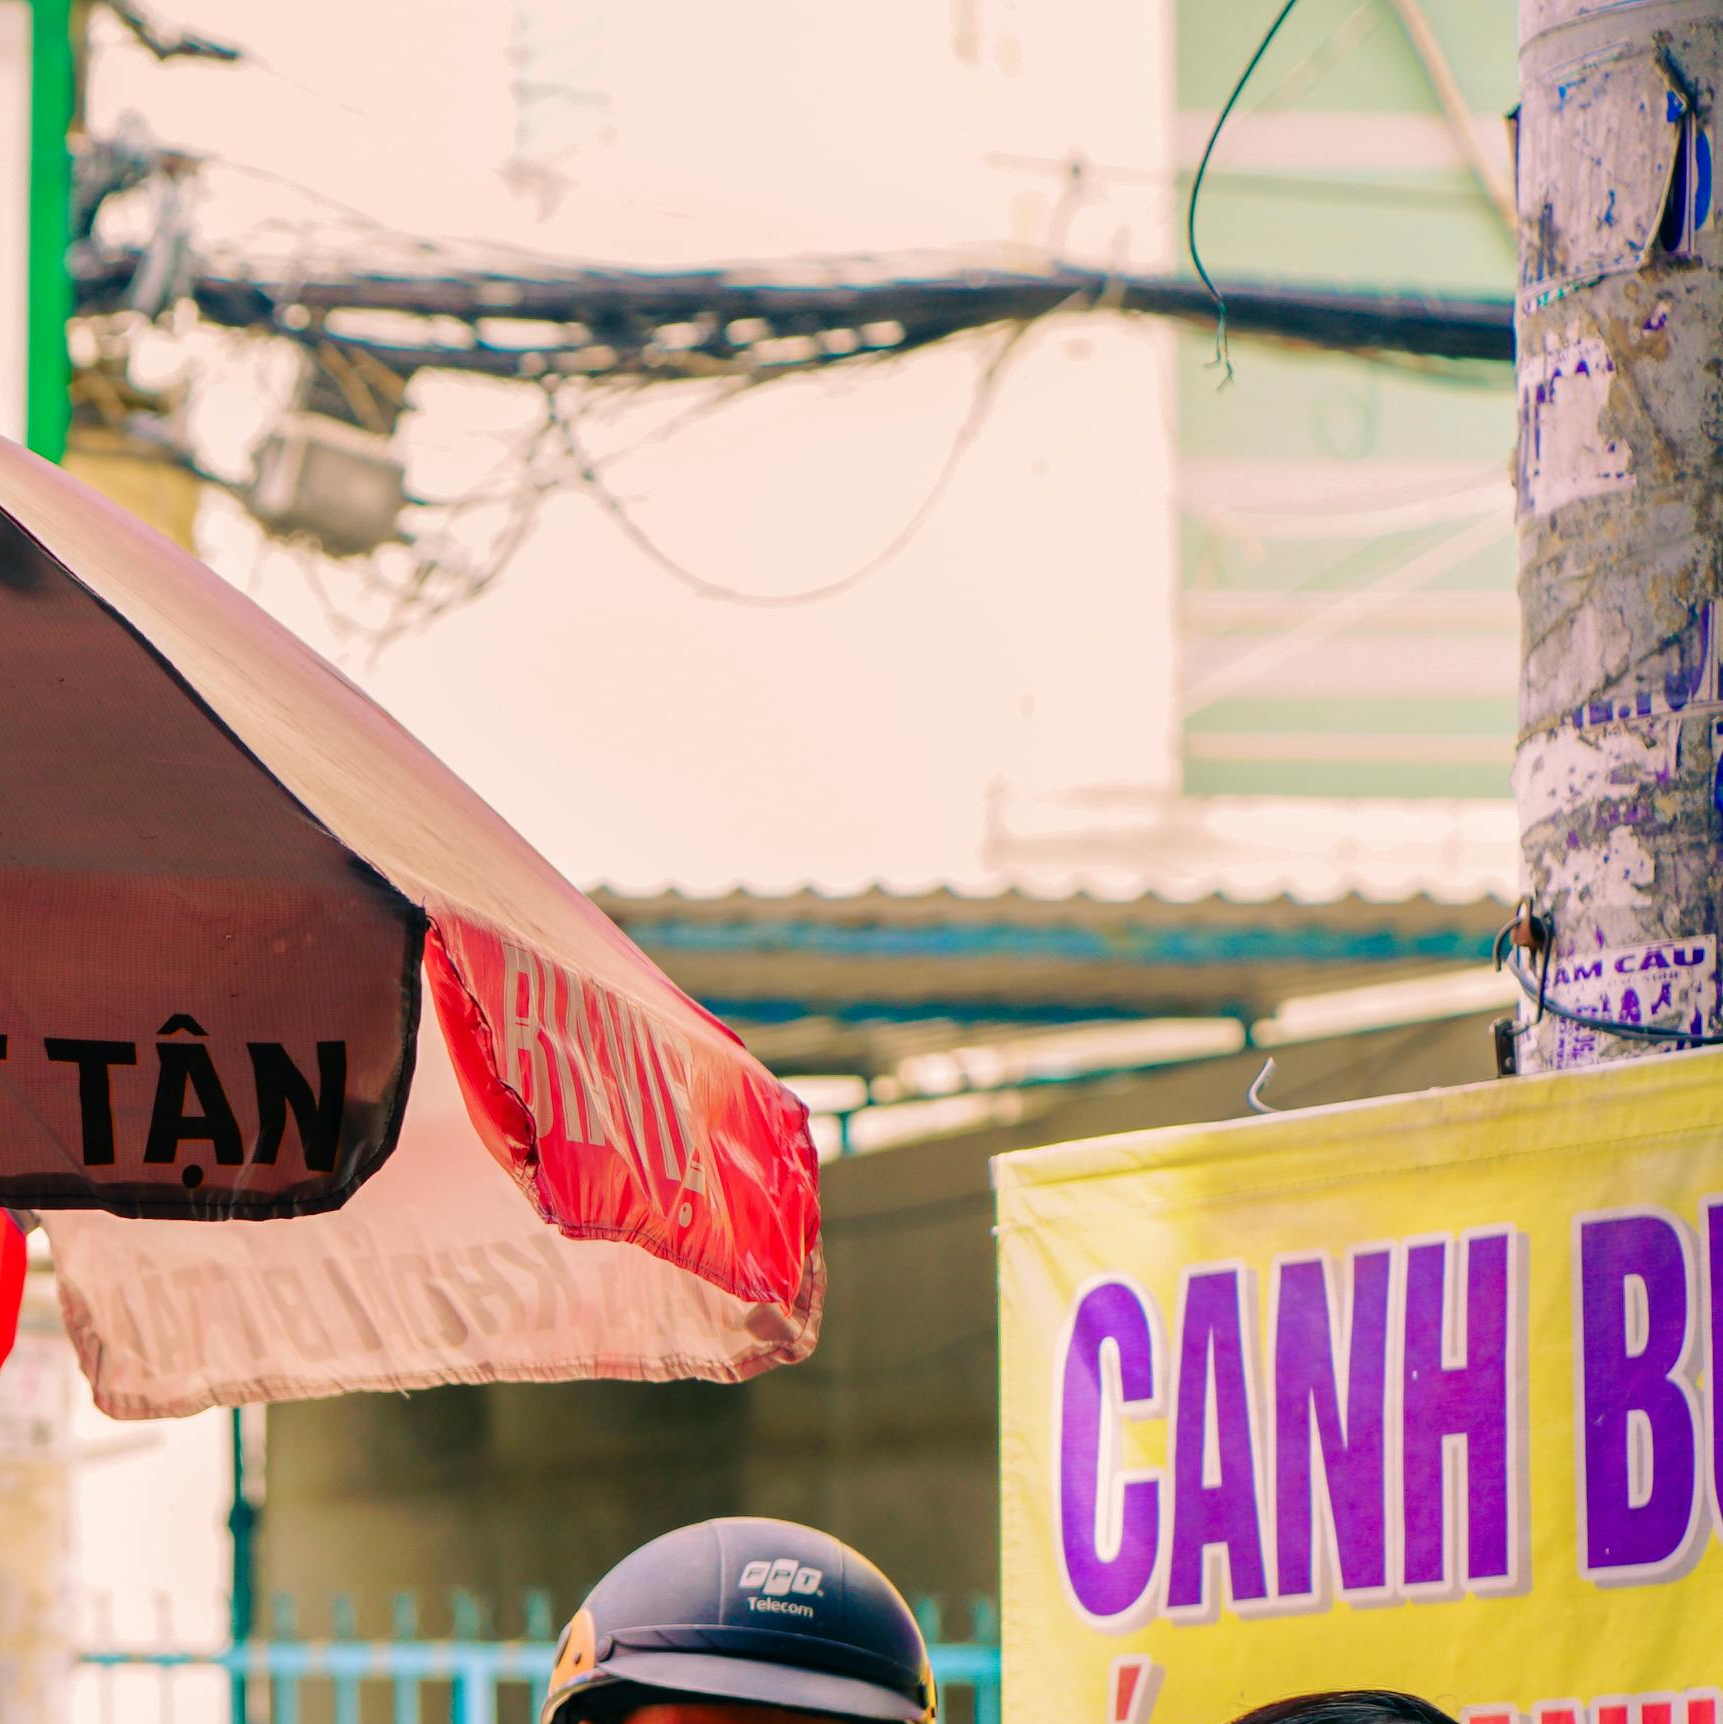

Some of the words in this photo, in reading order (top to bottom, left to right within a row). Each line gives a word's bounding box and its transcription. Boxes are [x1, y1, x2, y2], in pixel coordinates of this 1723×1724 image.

[43, 1013, 349, 1190] TẬN
[1060, 1232, 1510, 1616] CANH
[1579, 1204, 1723, 1570] B
[740, 1559, 822, 1596] FPT
[747, 1597, 814, 1618] Telecom
